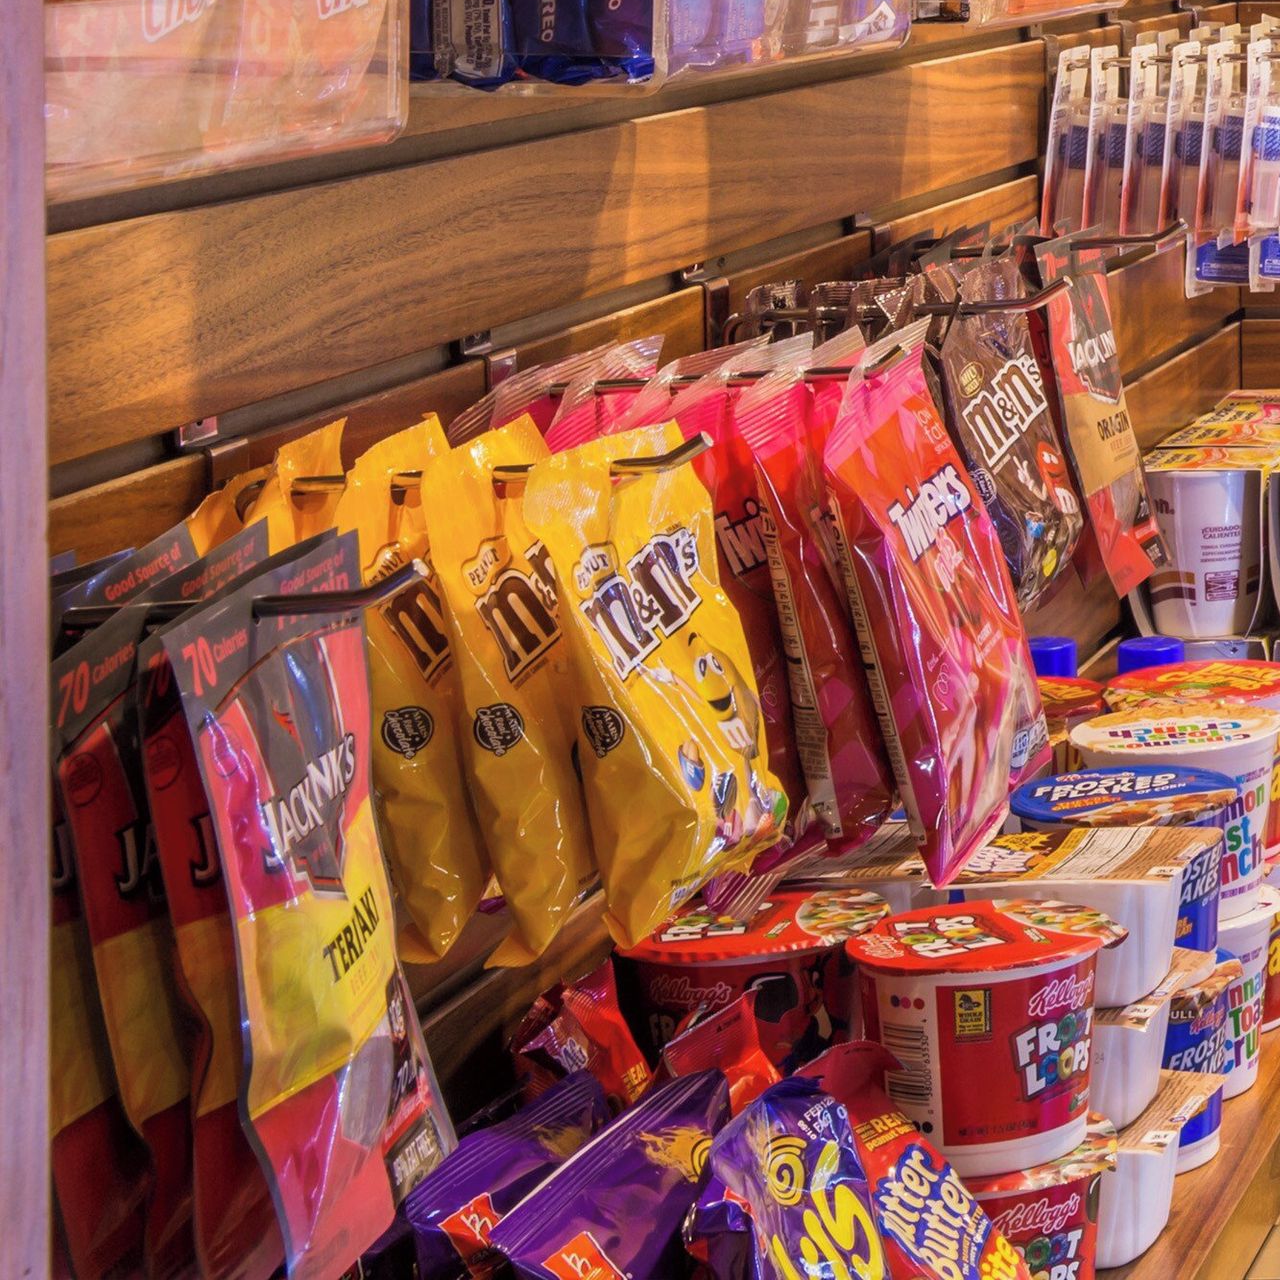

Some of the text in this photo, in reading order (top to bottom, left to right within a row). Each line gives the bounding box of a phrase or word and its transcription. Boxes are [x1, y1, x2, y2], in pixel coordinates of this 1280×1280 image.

[961, 352, 1047, 468] m&m's
[105, 575, 135, 602] Good
[134, 556, 169, 587] Source
[279, 573, 304, 596] Good
[303, 559, 329, 585] Source
[467, 547, 500, 587] PEANUT
[181, 627, 249, 698] 70 Calories
[56, 641, 135, 728] 70 Calories
[1034, 773, 1177, 799] FROSTED
[1050, 779, 1168, 802] FLAKES
[1153, 782, 1187, 793] CORN
[1179, 865, 1220, 906] AKES
[1171, 1009, 1195, 1020] ULL
